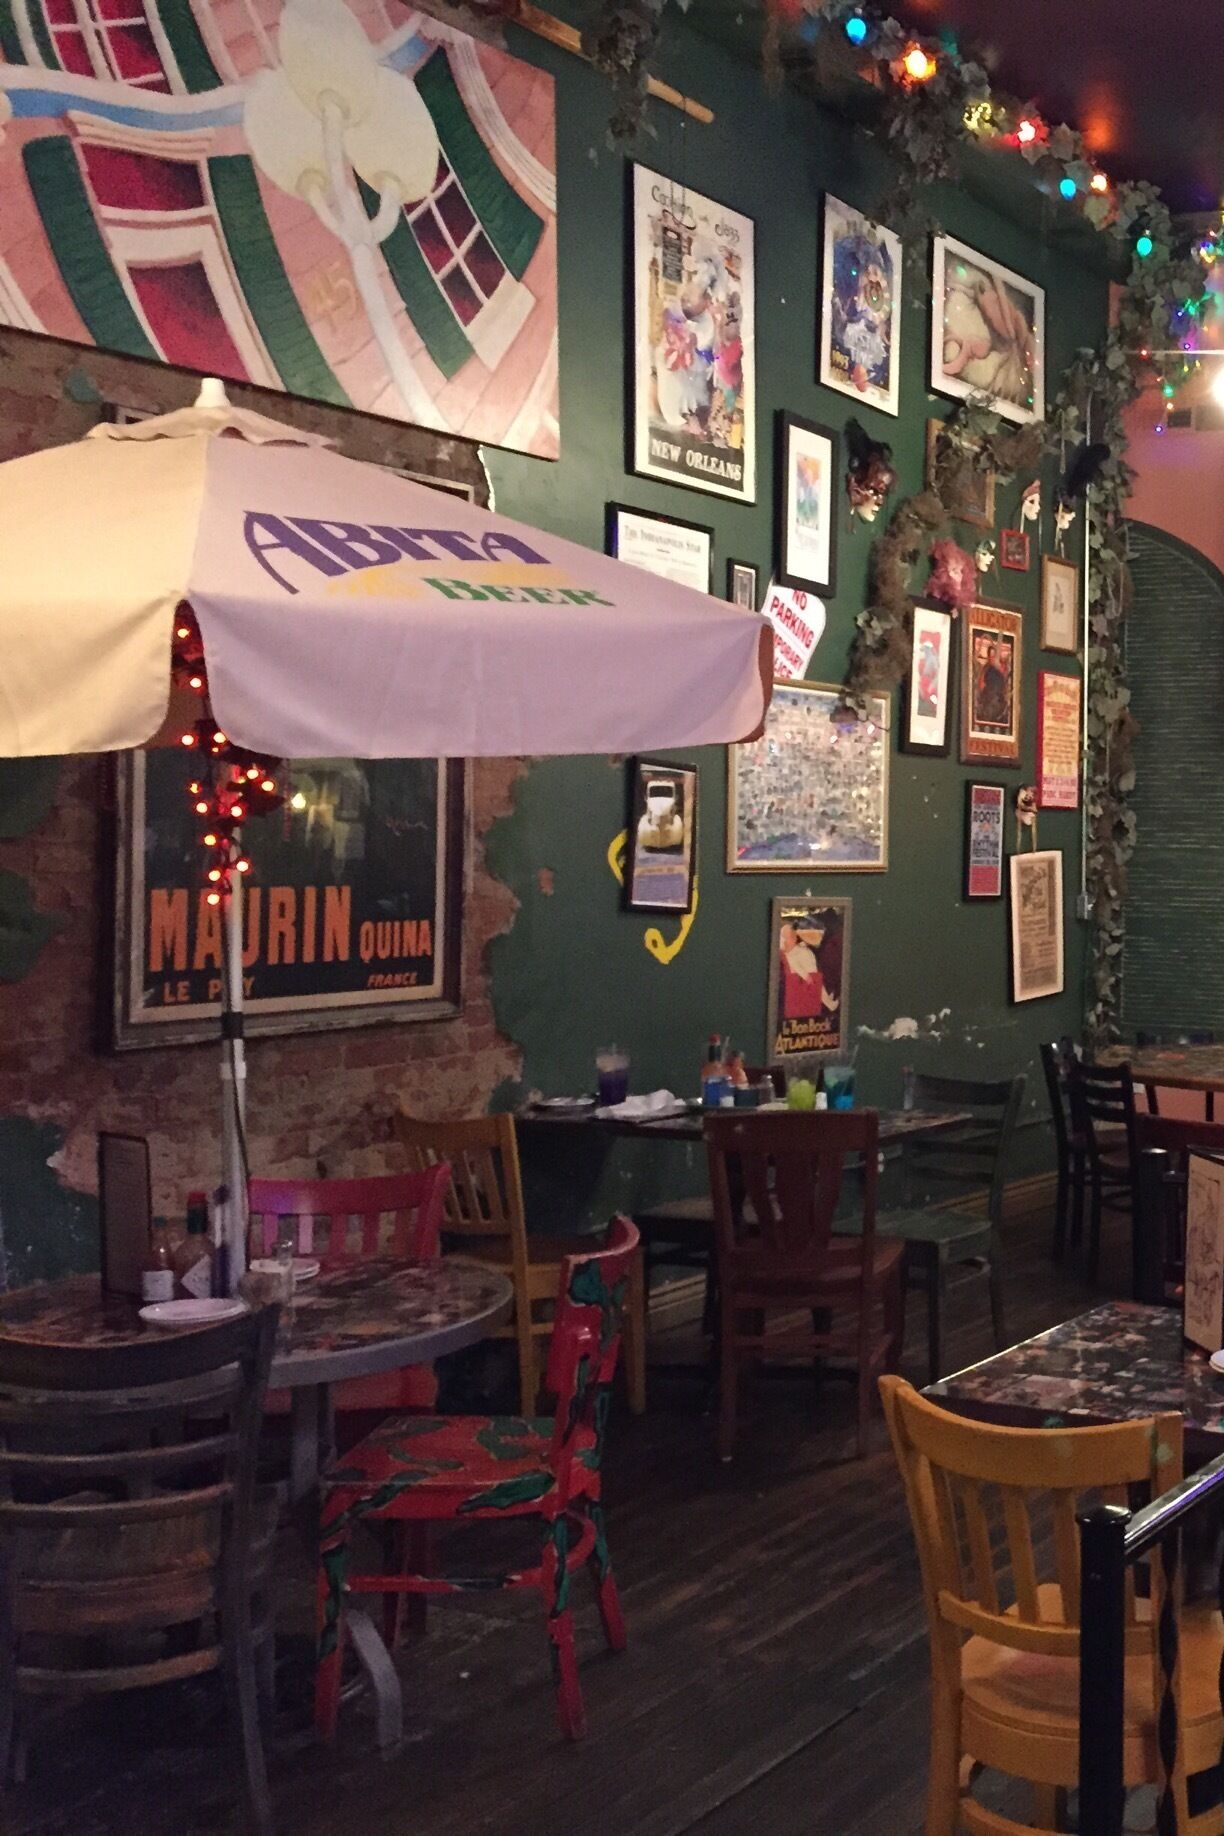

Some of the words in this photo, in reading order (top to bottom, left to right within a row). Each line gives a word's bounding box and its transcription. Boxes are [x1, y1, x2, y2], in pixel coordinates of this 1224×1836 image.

[651, 438, 681, 462] NEW
[685, 449, 742, 481] ORLEANS
[243, 510, 552, 595] ABITA
[423, 577, 616, 607] BEER
[792, 589, 808, 611] NO
[770, 595, 815, 649] PARKING
[973, 810, 1001, 824] ROOTS
[149, 885, 352, 973] MAURIN
[359, 919, 433, 964] QUINA
[164, 979, 190, 1003] LE
[208, 976, 256, 1000] PY
[367, 971, 418, 988] FRANCE
[776, 1032, 840, 1055] ATLANTIQUE
